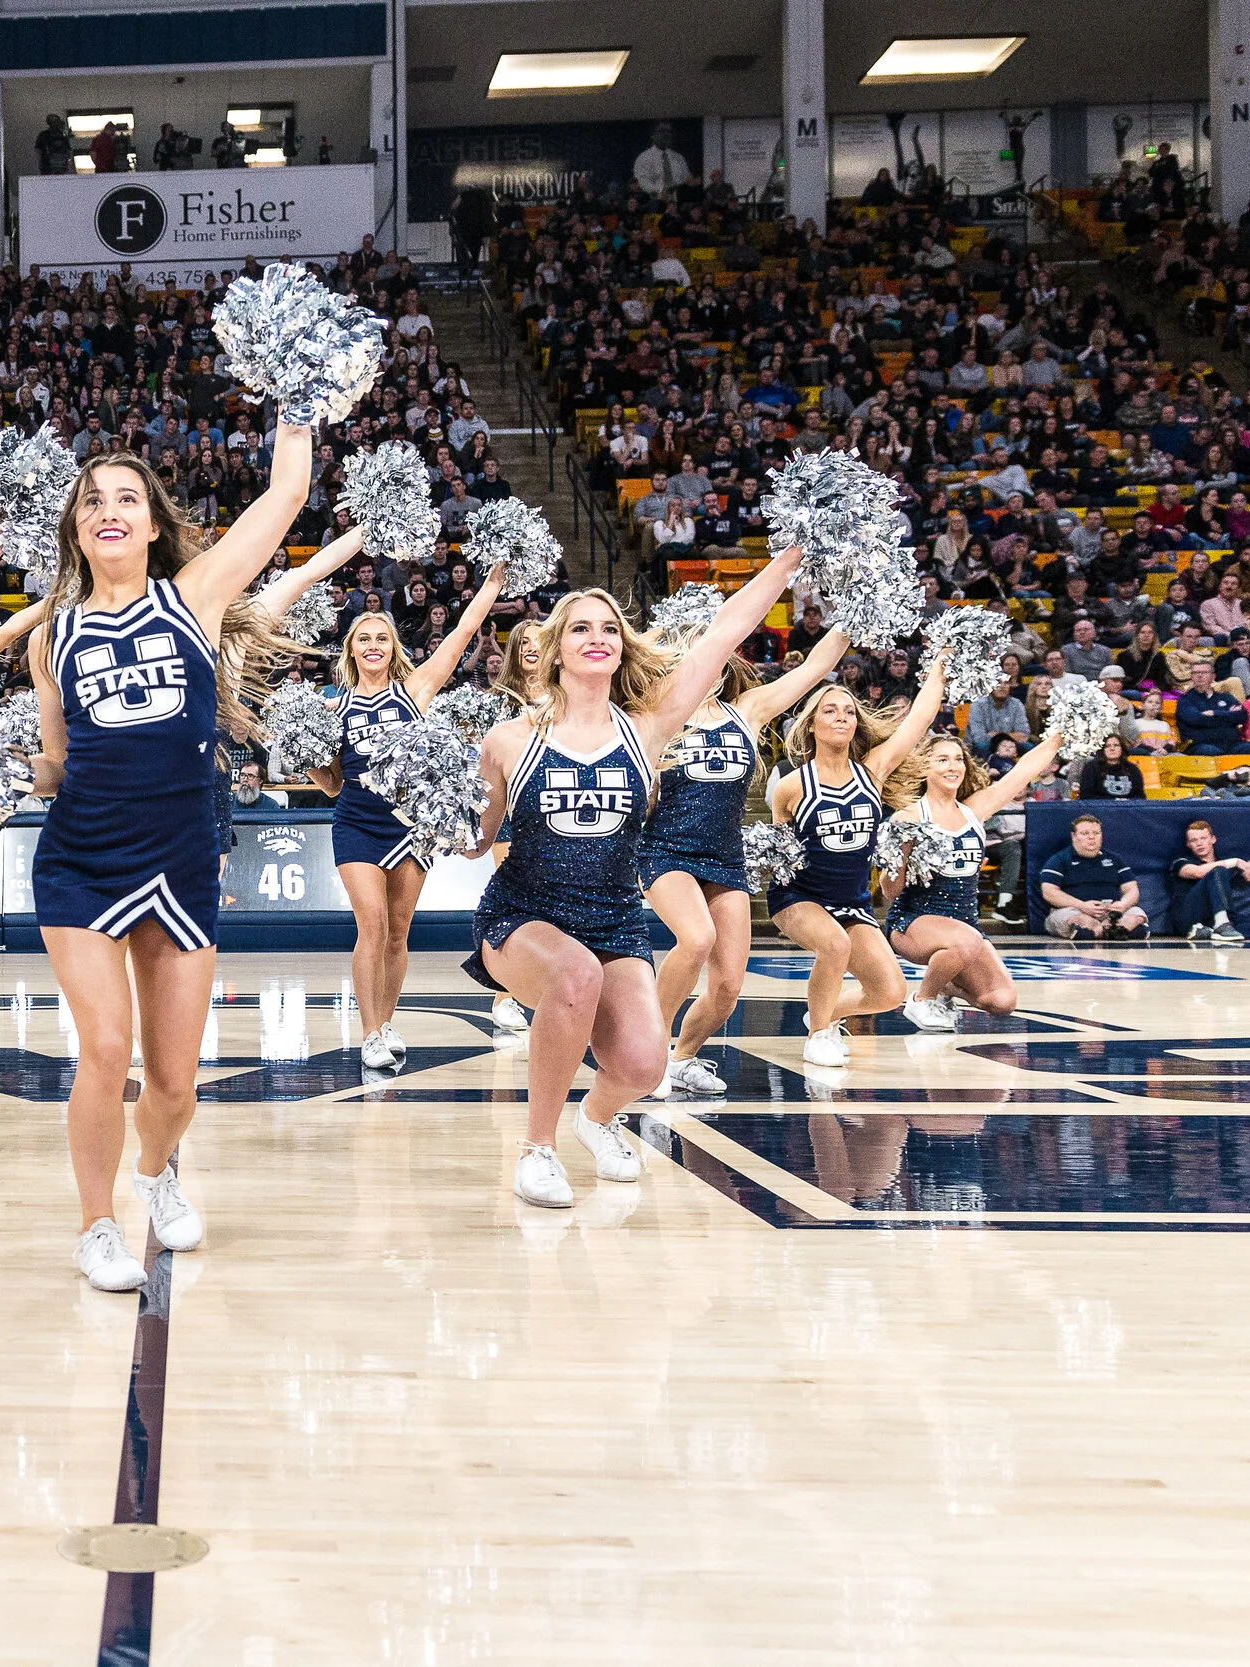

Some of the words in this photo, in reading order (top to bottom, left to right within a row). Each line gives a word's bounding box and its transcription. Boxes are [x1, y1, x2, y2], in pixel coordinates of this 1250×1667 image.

[797, 117, 818, 137] M
[491, 170, 590, 202] CONSERVIC
[178, 187, 296, 226] Fisher
[115, 199, 147, 240] F
[172, 228, 217, 243] Home
[220, 225, 303, 242] Furnishings
[74, 657, 188, 708] STATE
[346, 720, 403, 746] STA
[677, 746, 751, 766] STATE
[539, 789, 633, 814] STATE
[257, 827, 307, 842] NEVADA
[815, 817, 875, 837] STATE
[258, 863, 306, 901] 46
